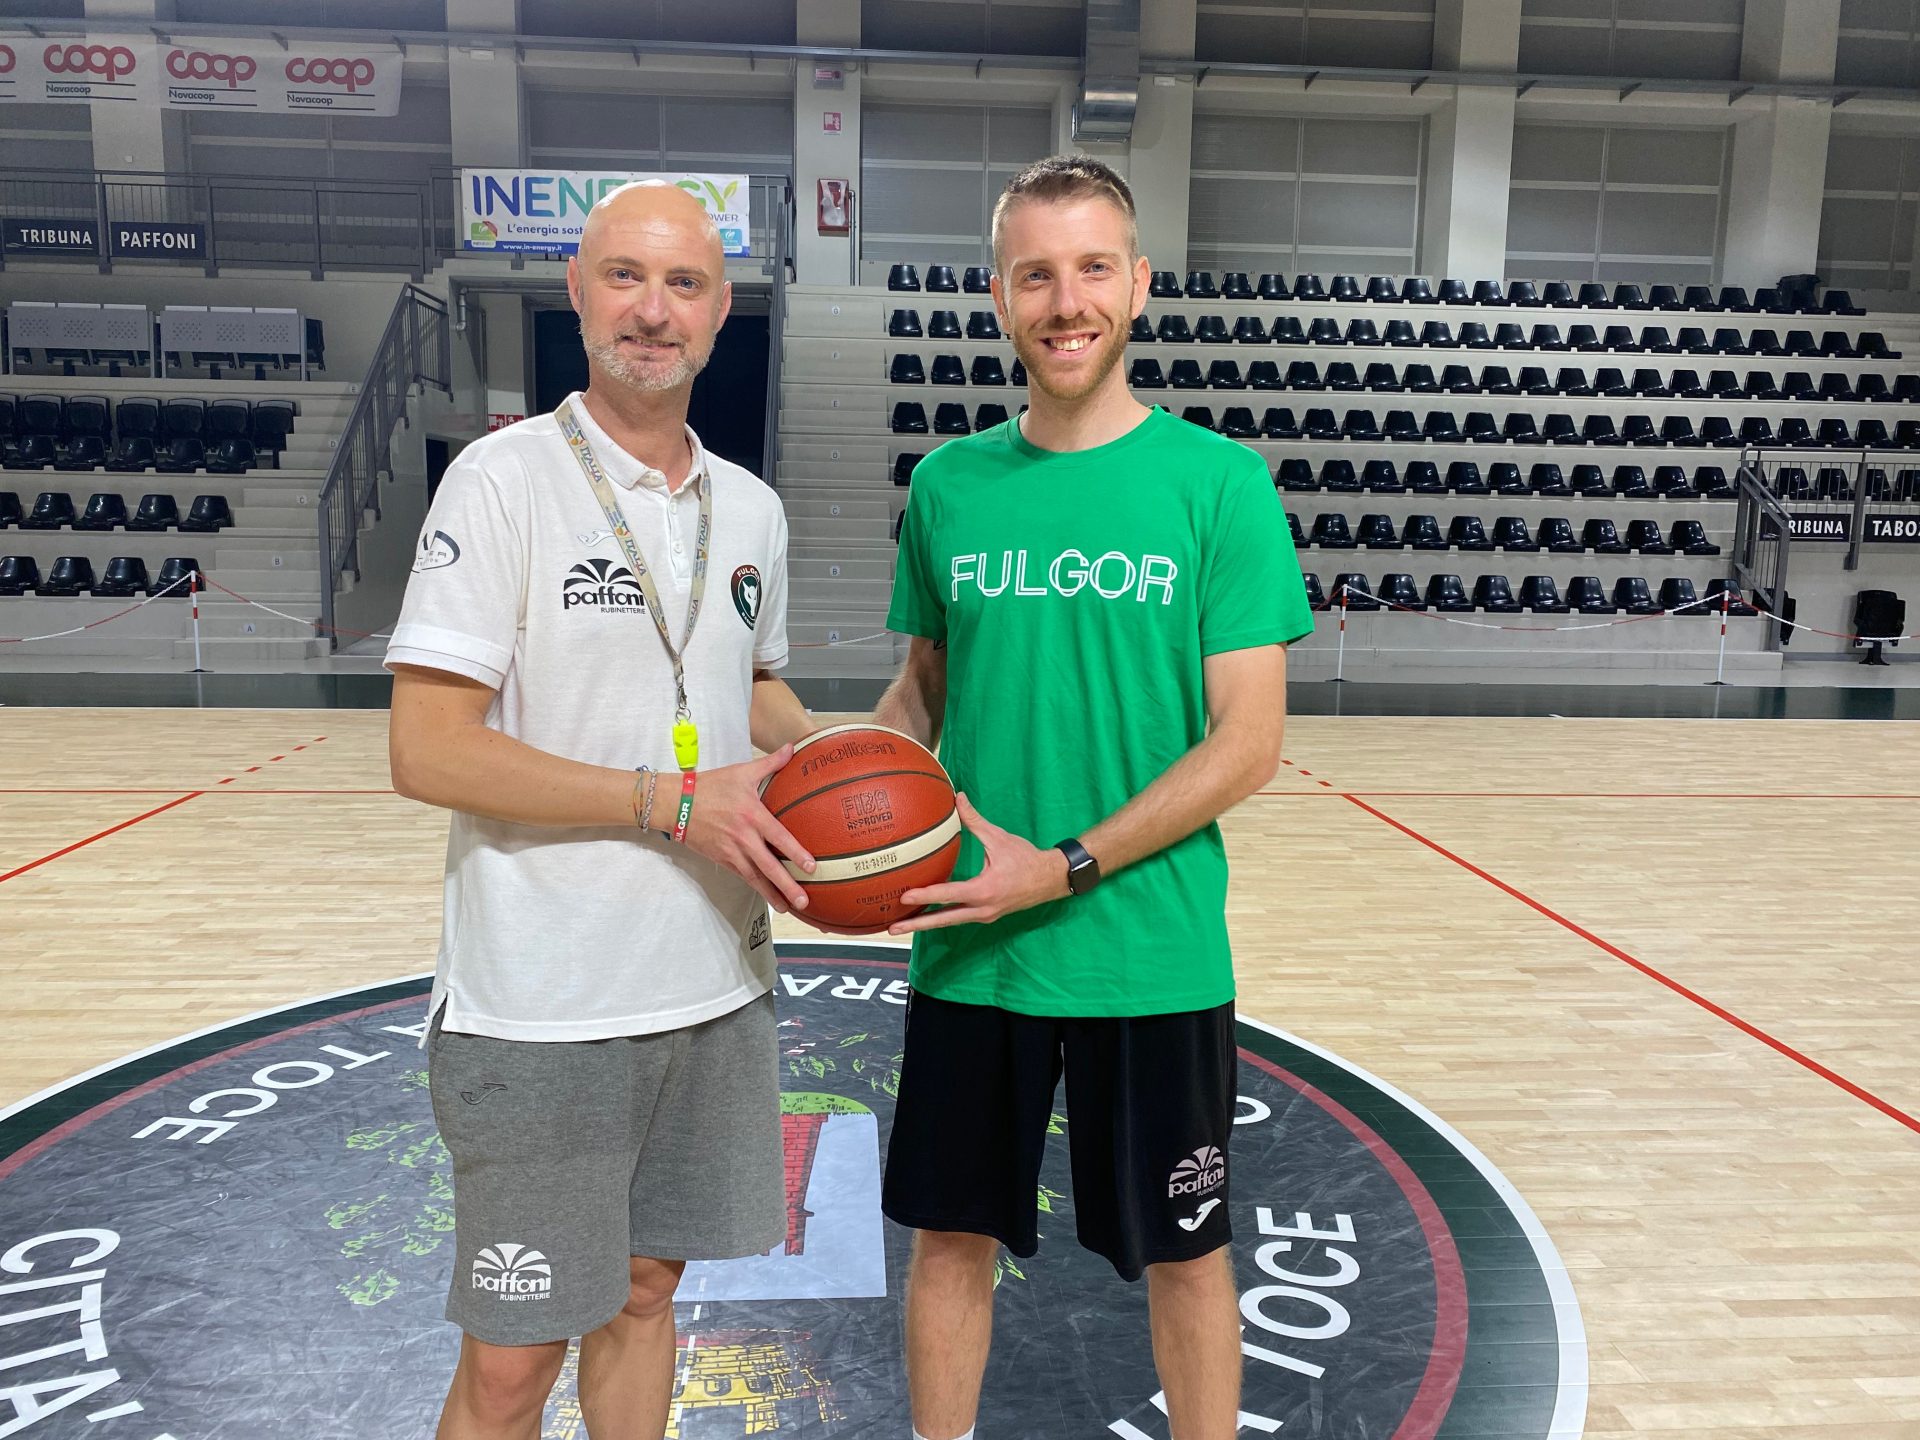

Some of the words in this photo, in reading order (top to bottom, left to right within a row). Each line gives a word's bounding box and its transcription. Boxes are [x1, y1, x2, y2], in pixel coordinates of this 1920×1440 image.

[44, 44, 136, 81] coop
[166, 50, 257, 88] coop
[285, 57, 375, 92] coop
[46, 84, 91, 95] Novacoop
[168, 90, 215, 101] Novacoop
[287, 94, 333, 106] Novacoop
[472, 175, 738, 217] INENY
[708, 213, 739, 222] OWER
[20, 229, 93, 245] TRIBUNA
[120, 231, 196, 249] PAFFONI
[507, 223, 559, 236] L'energia
[561, 225, 583, 235] sost
[502, 243, 562, 253] www.in-energy.it
[1788, 520, 1844, 534] RIBUNA
[951, 548, 1178, 606] FULGOR
[563, 585, 646, 610] paffoni
[600, 606, 647, 615] RUBINETTERIE
[801, 741, 897, 777] molten
[841, 788, 891, 819] FIBA
[675, 802, 691, 842] ULGOR
[130, 1044, 393, 1145] TOCE
[1168, 1166, 1225, 1198] paffoni
[472, 1271, 552, 1293] paffoni
[499, 1291, 551, 1302] RUBINETTERIE
